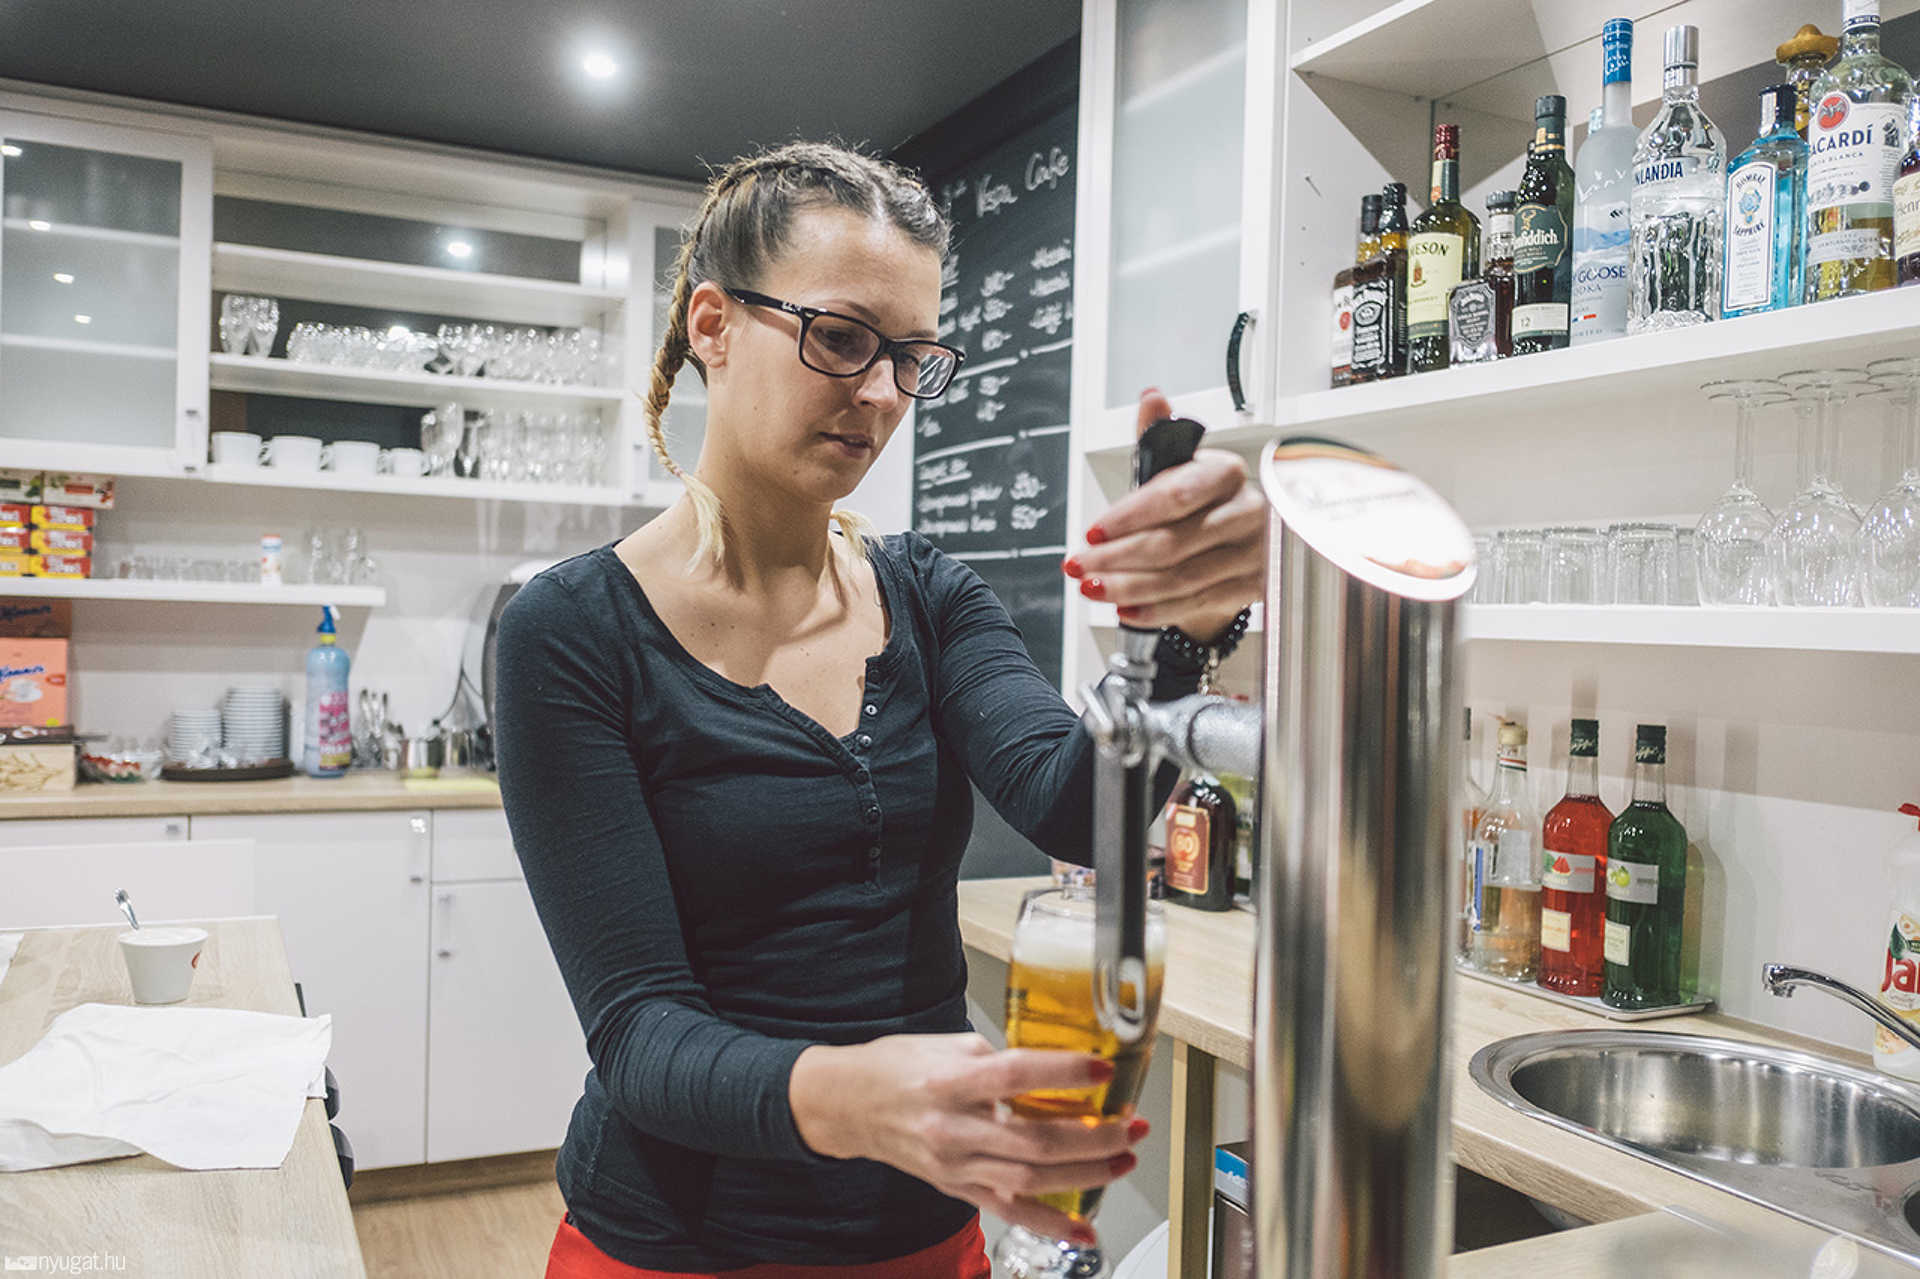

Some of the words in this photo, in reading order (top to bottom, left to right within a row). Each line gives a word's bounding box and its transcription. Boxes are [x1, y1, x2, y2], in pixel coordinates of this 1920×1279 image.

[1809, 124, 1873, 155] ACARDÍ
[1635, 161, 1684, 185] NLANDIA
[1410, 241, 1449, 256] ESON
[1577, 265, 1626, 283] GOOSE
[1881, 947, 1920, 994] Ja
